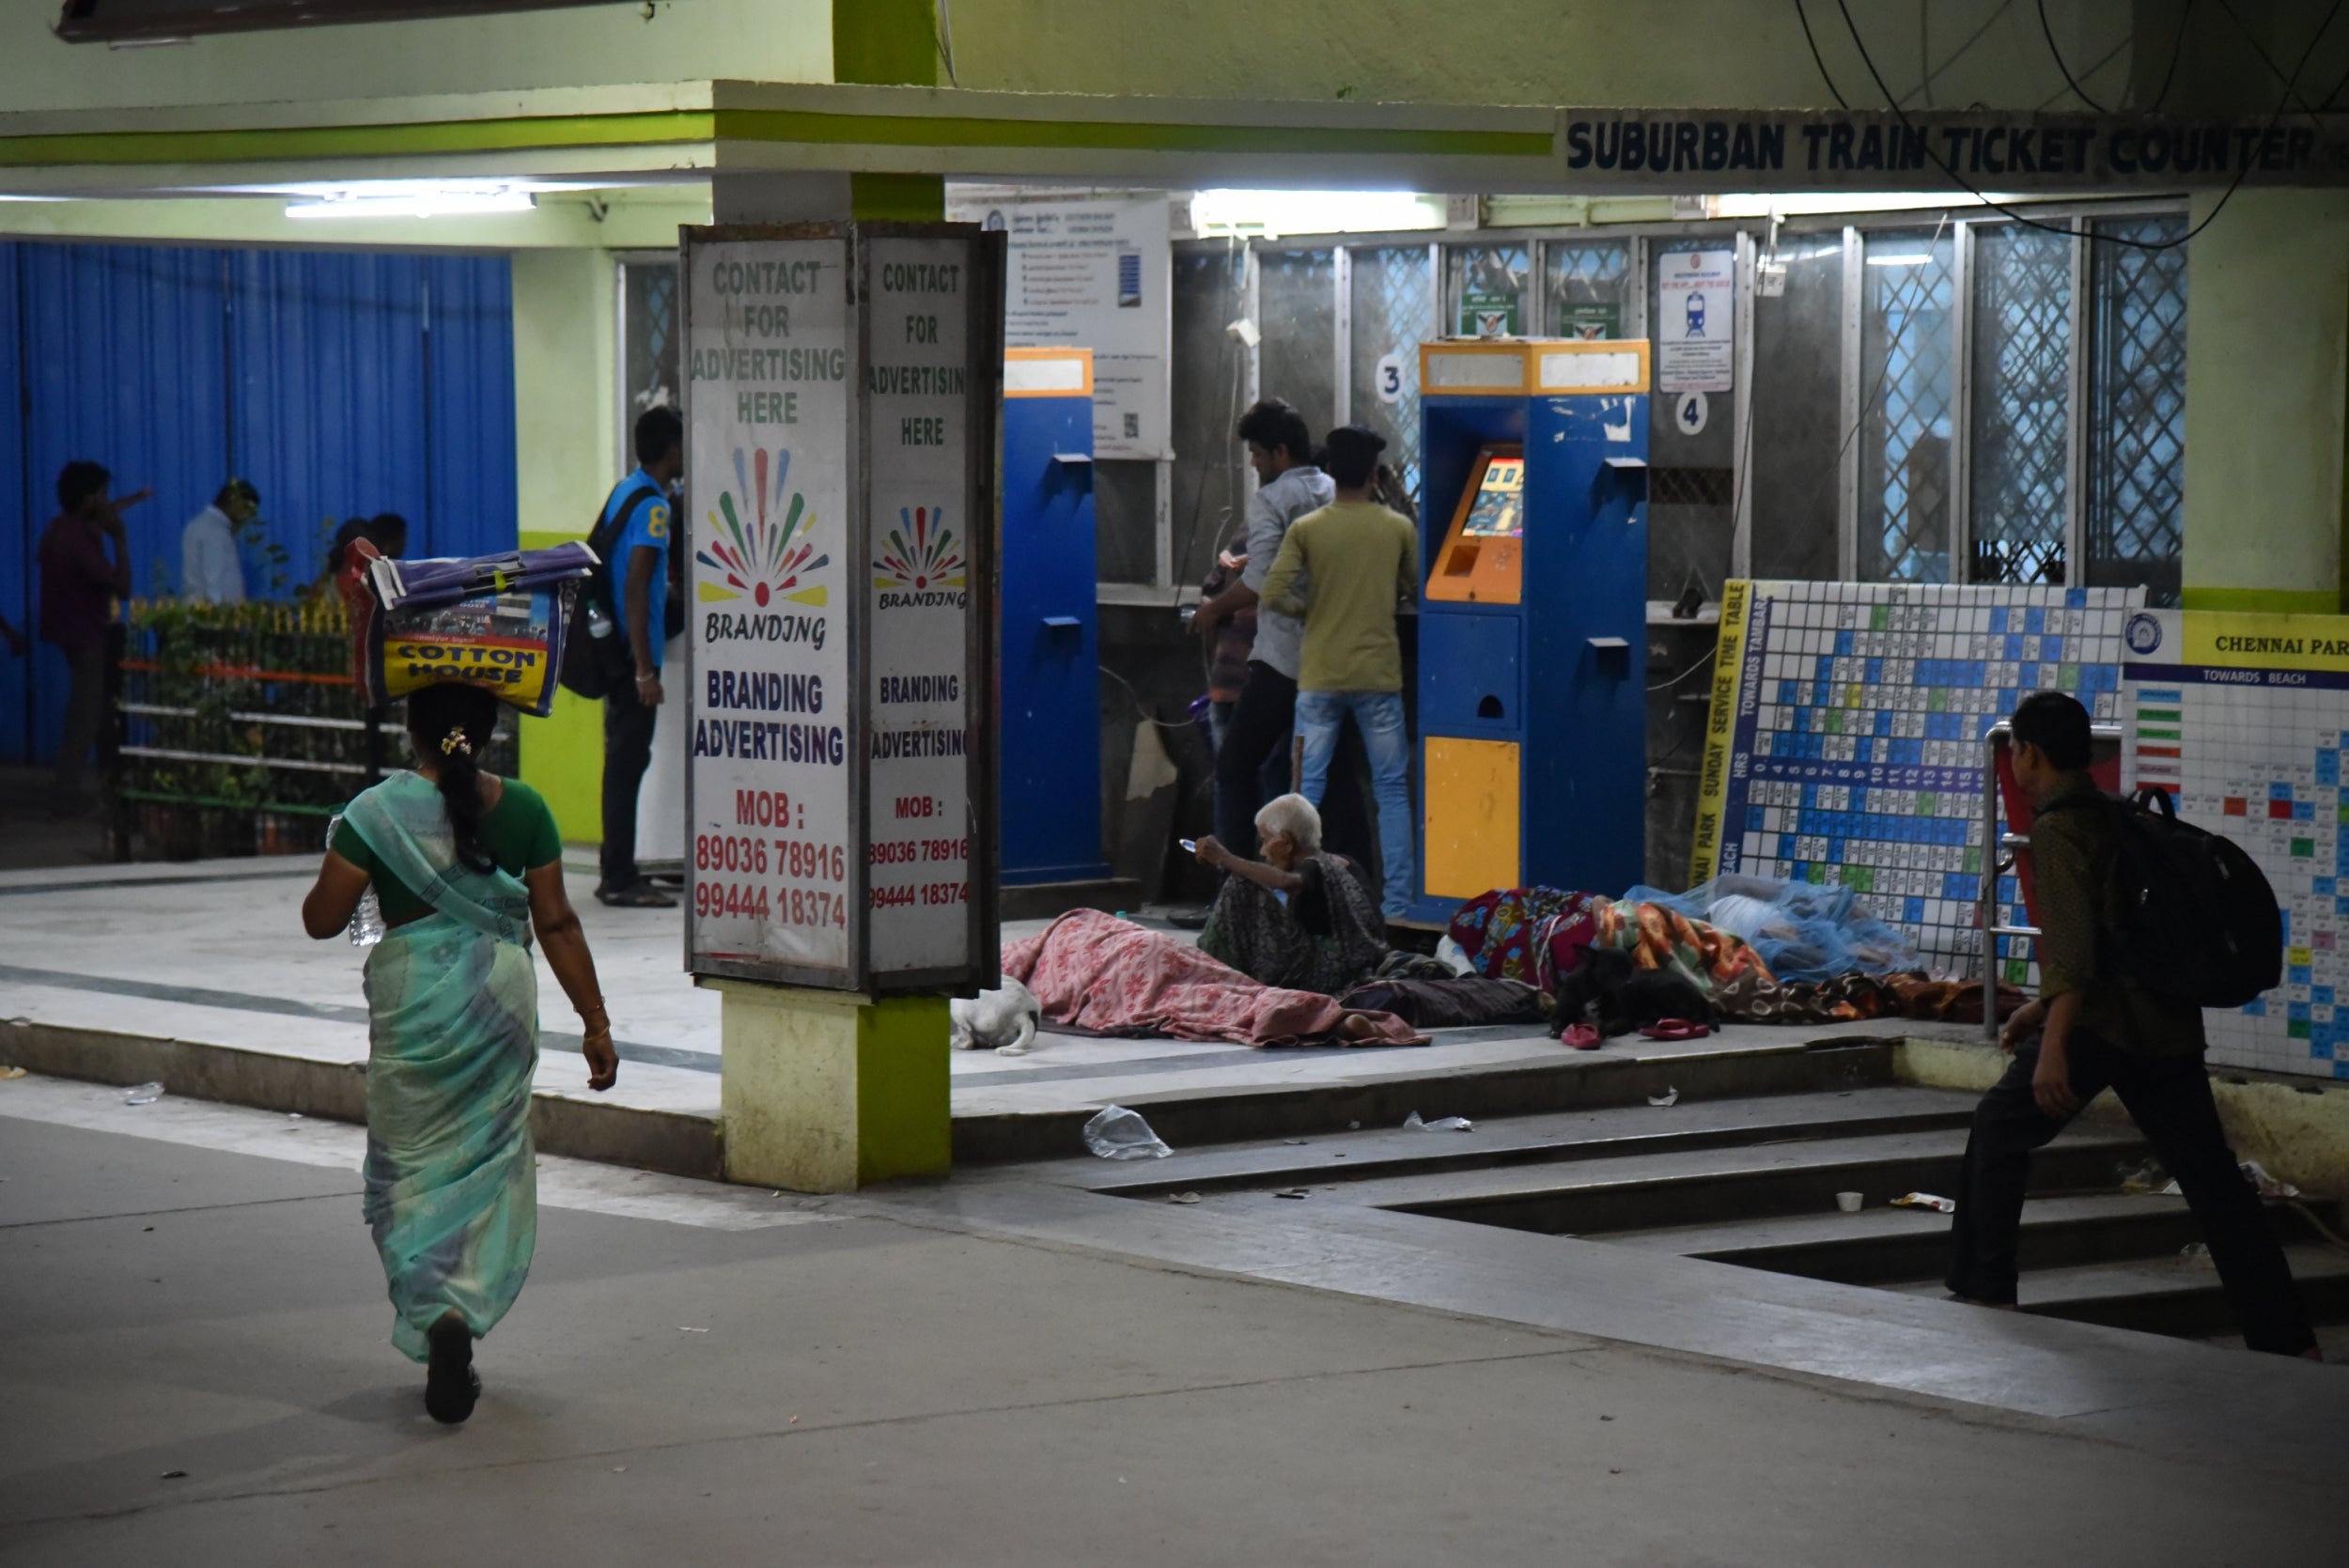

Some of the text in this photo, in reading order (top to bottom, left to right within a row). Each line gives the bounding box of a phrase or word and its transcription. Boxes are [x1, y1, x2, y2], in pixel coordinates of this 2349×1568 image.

[1567, 121, 1784, 172] SUBURBAN
[1803, 124, 1928, 171] TRAIN
[1943, 127, 2096, 174] TICKET
[2108, 127, 2315, 174] COUNTER
[712, 261, 821, 295] CONTACT
[882, 263, 960, 293] CONTACT
[744, 305, 790, 338] FOR
[906, 316, 938, 343] FOR
[691, 348, 845, 381] ADVERTISING
[1384, 365, 1400, 395] 3
[738, 391, 798, 424] HERE
[1682, 397, 1699, 427] 4
[901, 417, 944, 446] HERE
[647, 505, 668, 538] 8
[879, 591, 967, 611] BRANDING
[1725, 583, 1745, 627] TABLE
[706, 613, 827, 650] BRANDING
[2216, 636, 2349, 656] CHENNAI PAR
[397, 644, 535, 668] COTTON
[1719, 634, 1738, 669] TIME
[409, 663, 522, 684] HOUSE
[880, 675, 958, 704] BRANDING
[1740, 657, 1761, 716] TOWARDS
[2203, 669, 2307, 685] TOWARDS BEACH
[707, 670, 823, 714] BRANDING
[1712, 675, 1733, 734] SERVICE
[694, 720, 844, 766] ADVERTISING
[1703, 741, 1724, 798] SUNDAY
[1733, 753, 1749, 779] HRS
[1754, 763, 1766, 772] 0
[1772, 764, 1783, 773] 4
[1788, 766, 1800, 775] 5
[1805, 767, 1817, 776] 6
[1821, 768, 1833, 777] 7
[1838, 768, 1850, 778] 8
[1854, 769, 1866, 780] 9
[1870, 767, 1884, 784] 10
[1887, 768, 1902, 784] 11
[1905, 768, 1920, 785] 12
[1922, 770, 1936, 786] 13
[1940, 770, 1953, 787] 14
[1958, 771, 1972, 788] 15
[1698, 813, 1717, 849] PARK
[695, 834, 844, 881] 89036 78916
[921, 838, 969, 862] 78916
[1721, 842, 1739, 876] EACH
[695, 881, 845, 929] 99444 18374
[920, 882, 970, 907] 18374
